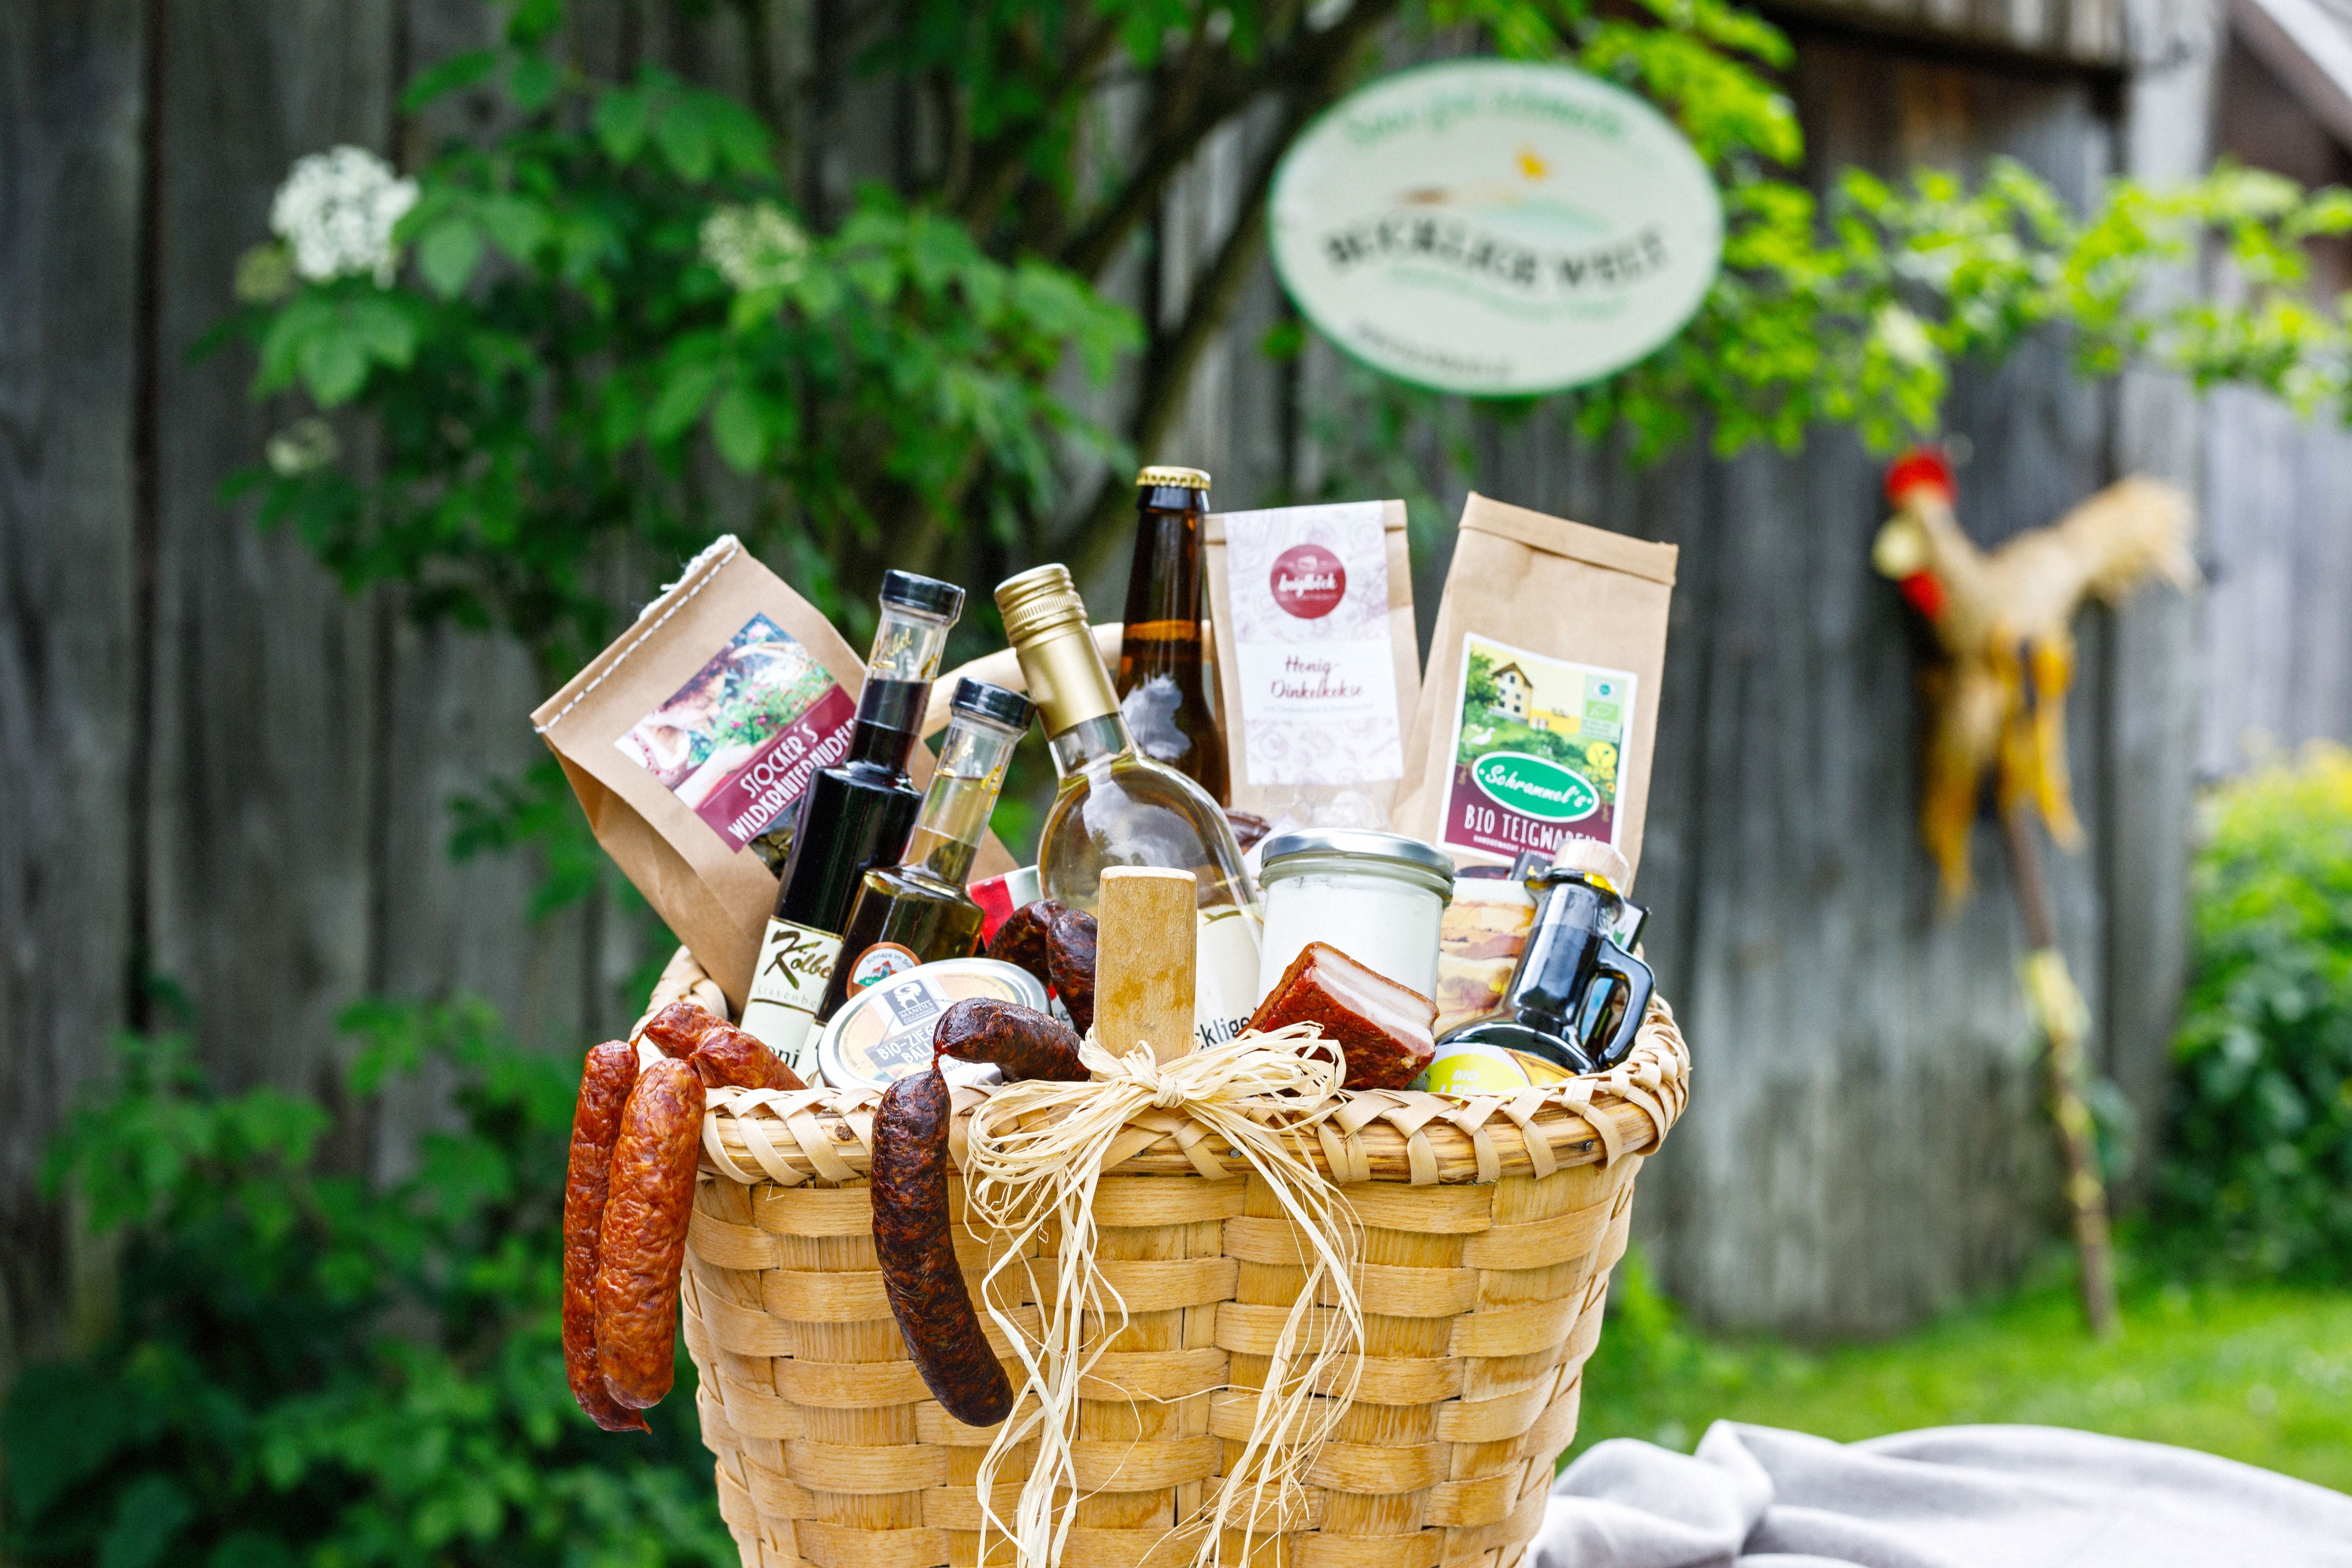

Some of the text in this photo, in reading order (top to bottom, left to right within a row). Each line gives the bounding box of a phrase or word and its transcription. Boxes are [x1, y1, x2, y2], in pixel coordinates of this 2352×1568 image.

[740, 723, 819, 799] STOCKER'S
[1485, 764, 1587, 808] Schrammel's
[1464, 804, 1495, 834] BIO
[866, 953, 892, 965] Schnaps
[900, 1001, 934, 1019] MANDLS
[903, 1007, 935, 1022] ZIEGENHOF
[1452, 1069, 1479, 1082] BIO
